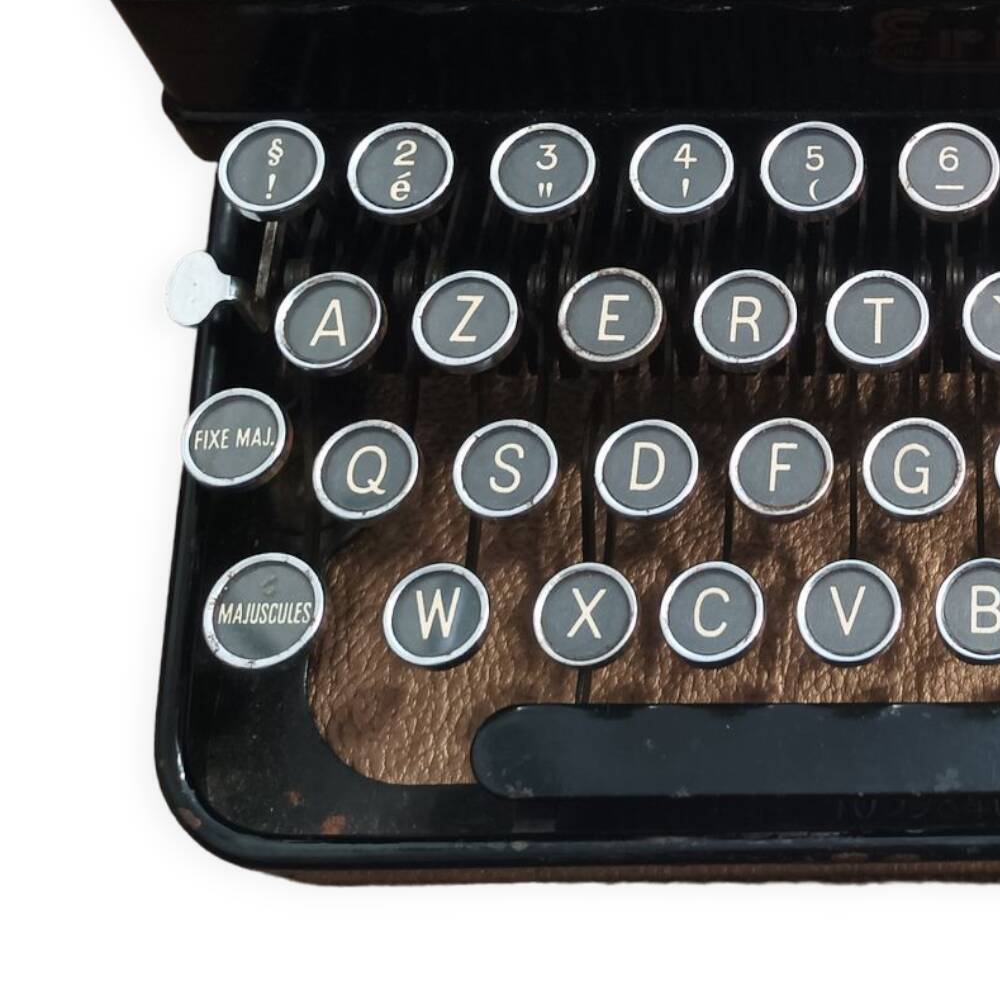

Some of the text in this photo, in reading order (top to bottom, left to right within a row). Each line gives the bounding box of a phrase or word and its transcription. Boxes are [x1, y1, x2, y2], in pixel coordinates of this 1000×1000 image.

[268, 139, 283, 166] §
[394, 140, 417, 165] 2
[537, 145, 557, 169] 3
[674, 144, 697, 168] 4
[806, 146, 823, 170] 5
[940, 147, 958, 171] 6
[266, 174, 276, 199] !
[391, 172, 410, 201] é
[809, 179, 818, 201] (
[310, 300, 346, 346] A
[450, 296, 483, 341] Z
[598, 295, 629, 340] E
[730, 297, 761, 342] R
[864, 298, 894, 343] T
[194, 427, 275, 449] FIXE MAJ.
[347, 446, 386, 494] Q
[490, 444, 523, 493] S
[630, 442, 665, 490] D
[770, 443, 797, 491] F
[894, 444, 930, 494] G
[218, 601, 312, 625] MAJUSCULES
[417, 588, 460, 639] W
[567, 588, 606, 638] X
[694, 588, 729, 637] C
[831, 586, 865, 635] V
